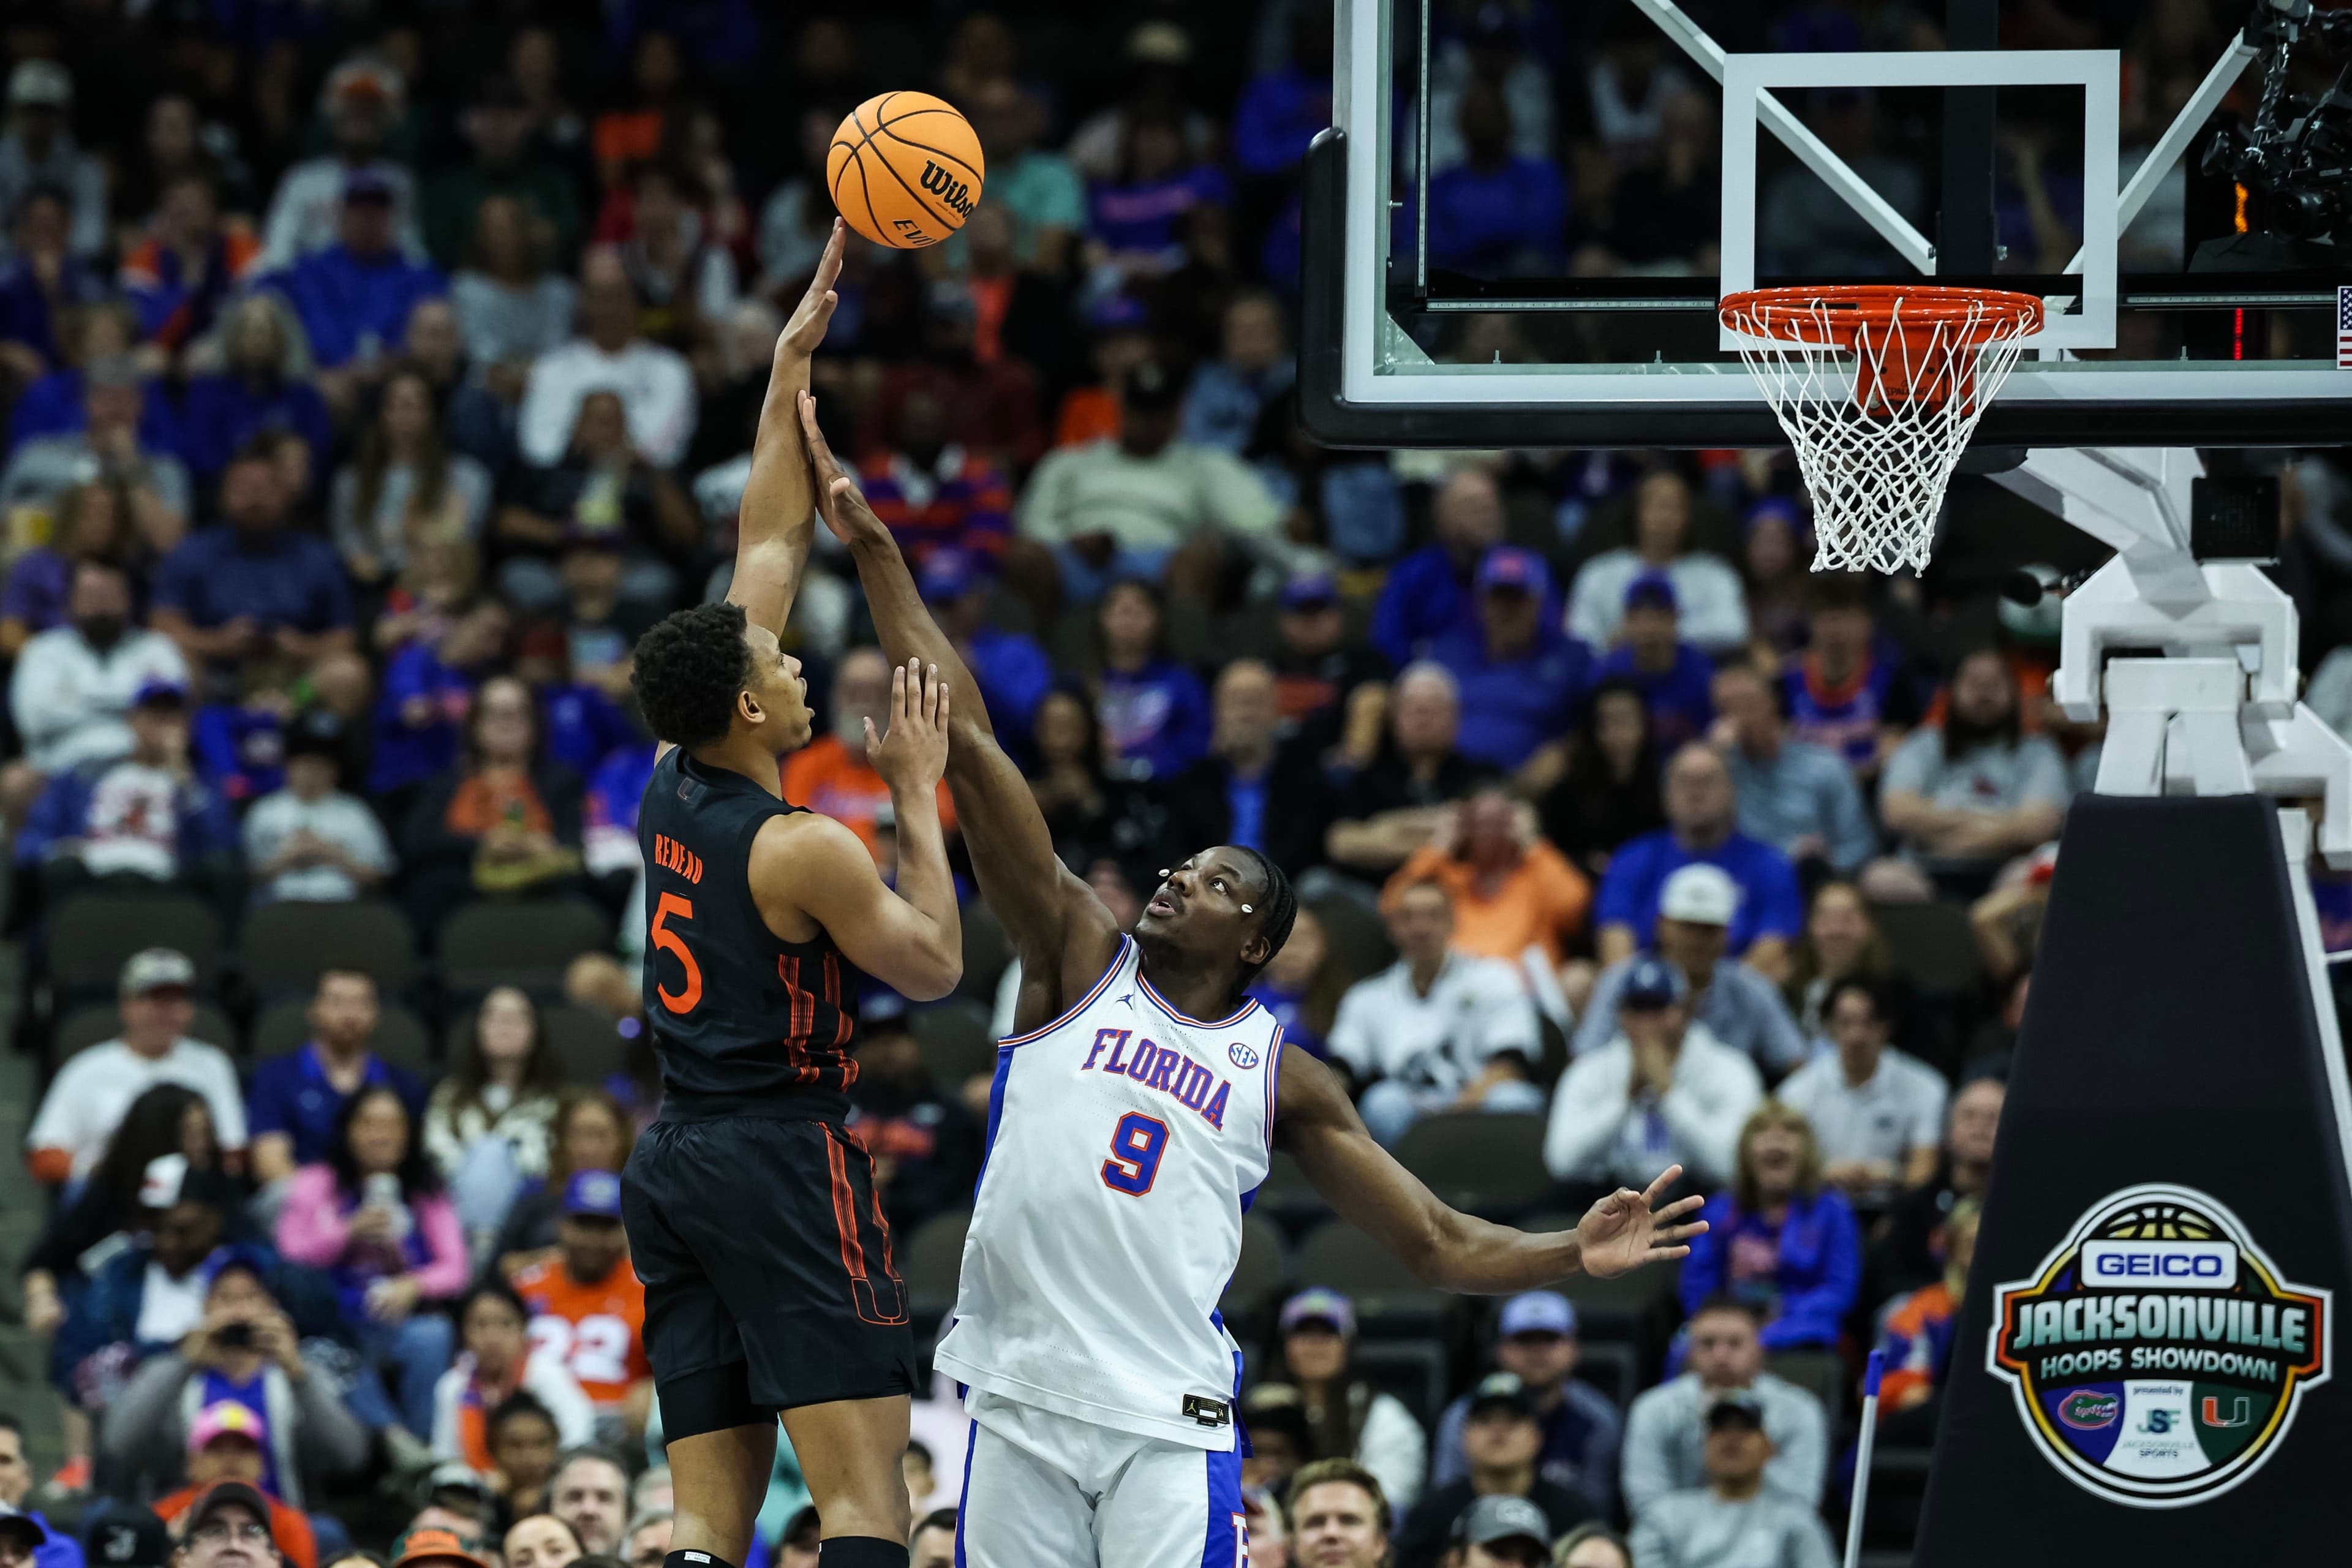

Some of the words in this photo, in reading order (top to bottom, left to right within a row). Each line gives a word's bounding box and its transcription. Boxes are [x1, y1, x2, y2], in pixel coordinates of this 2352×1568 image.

[921, 160, 974, 219] Wilso
[1885, 386, 1928, 396] SPALNG
[655, 834, 703, 884] RENEAU
[651, 891, 703, 1014] 5
[1230, 1044, 1257, 1068] SEC
[1081, 1028, 1231, 1131] FLORIDA
[1101, 1111, 1170, 1197] 9
[2097, 1253, 2223, 1277] GEICO
[2013, 1295, 2305, 1352] JACKSONVILLE
[2041, 1349, 2123, 1379] HOOPS
[2131, 1347, 2277, 1382] SHOWDOWN
[2133, 1386, 2171, 1395] presented
[2174, 1386, 2184, 1396] by
[2139, 1449, 2179, 1458] SPORTS
